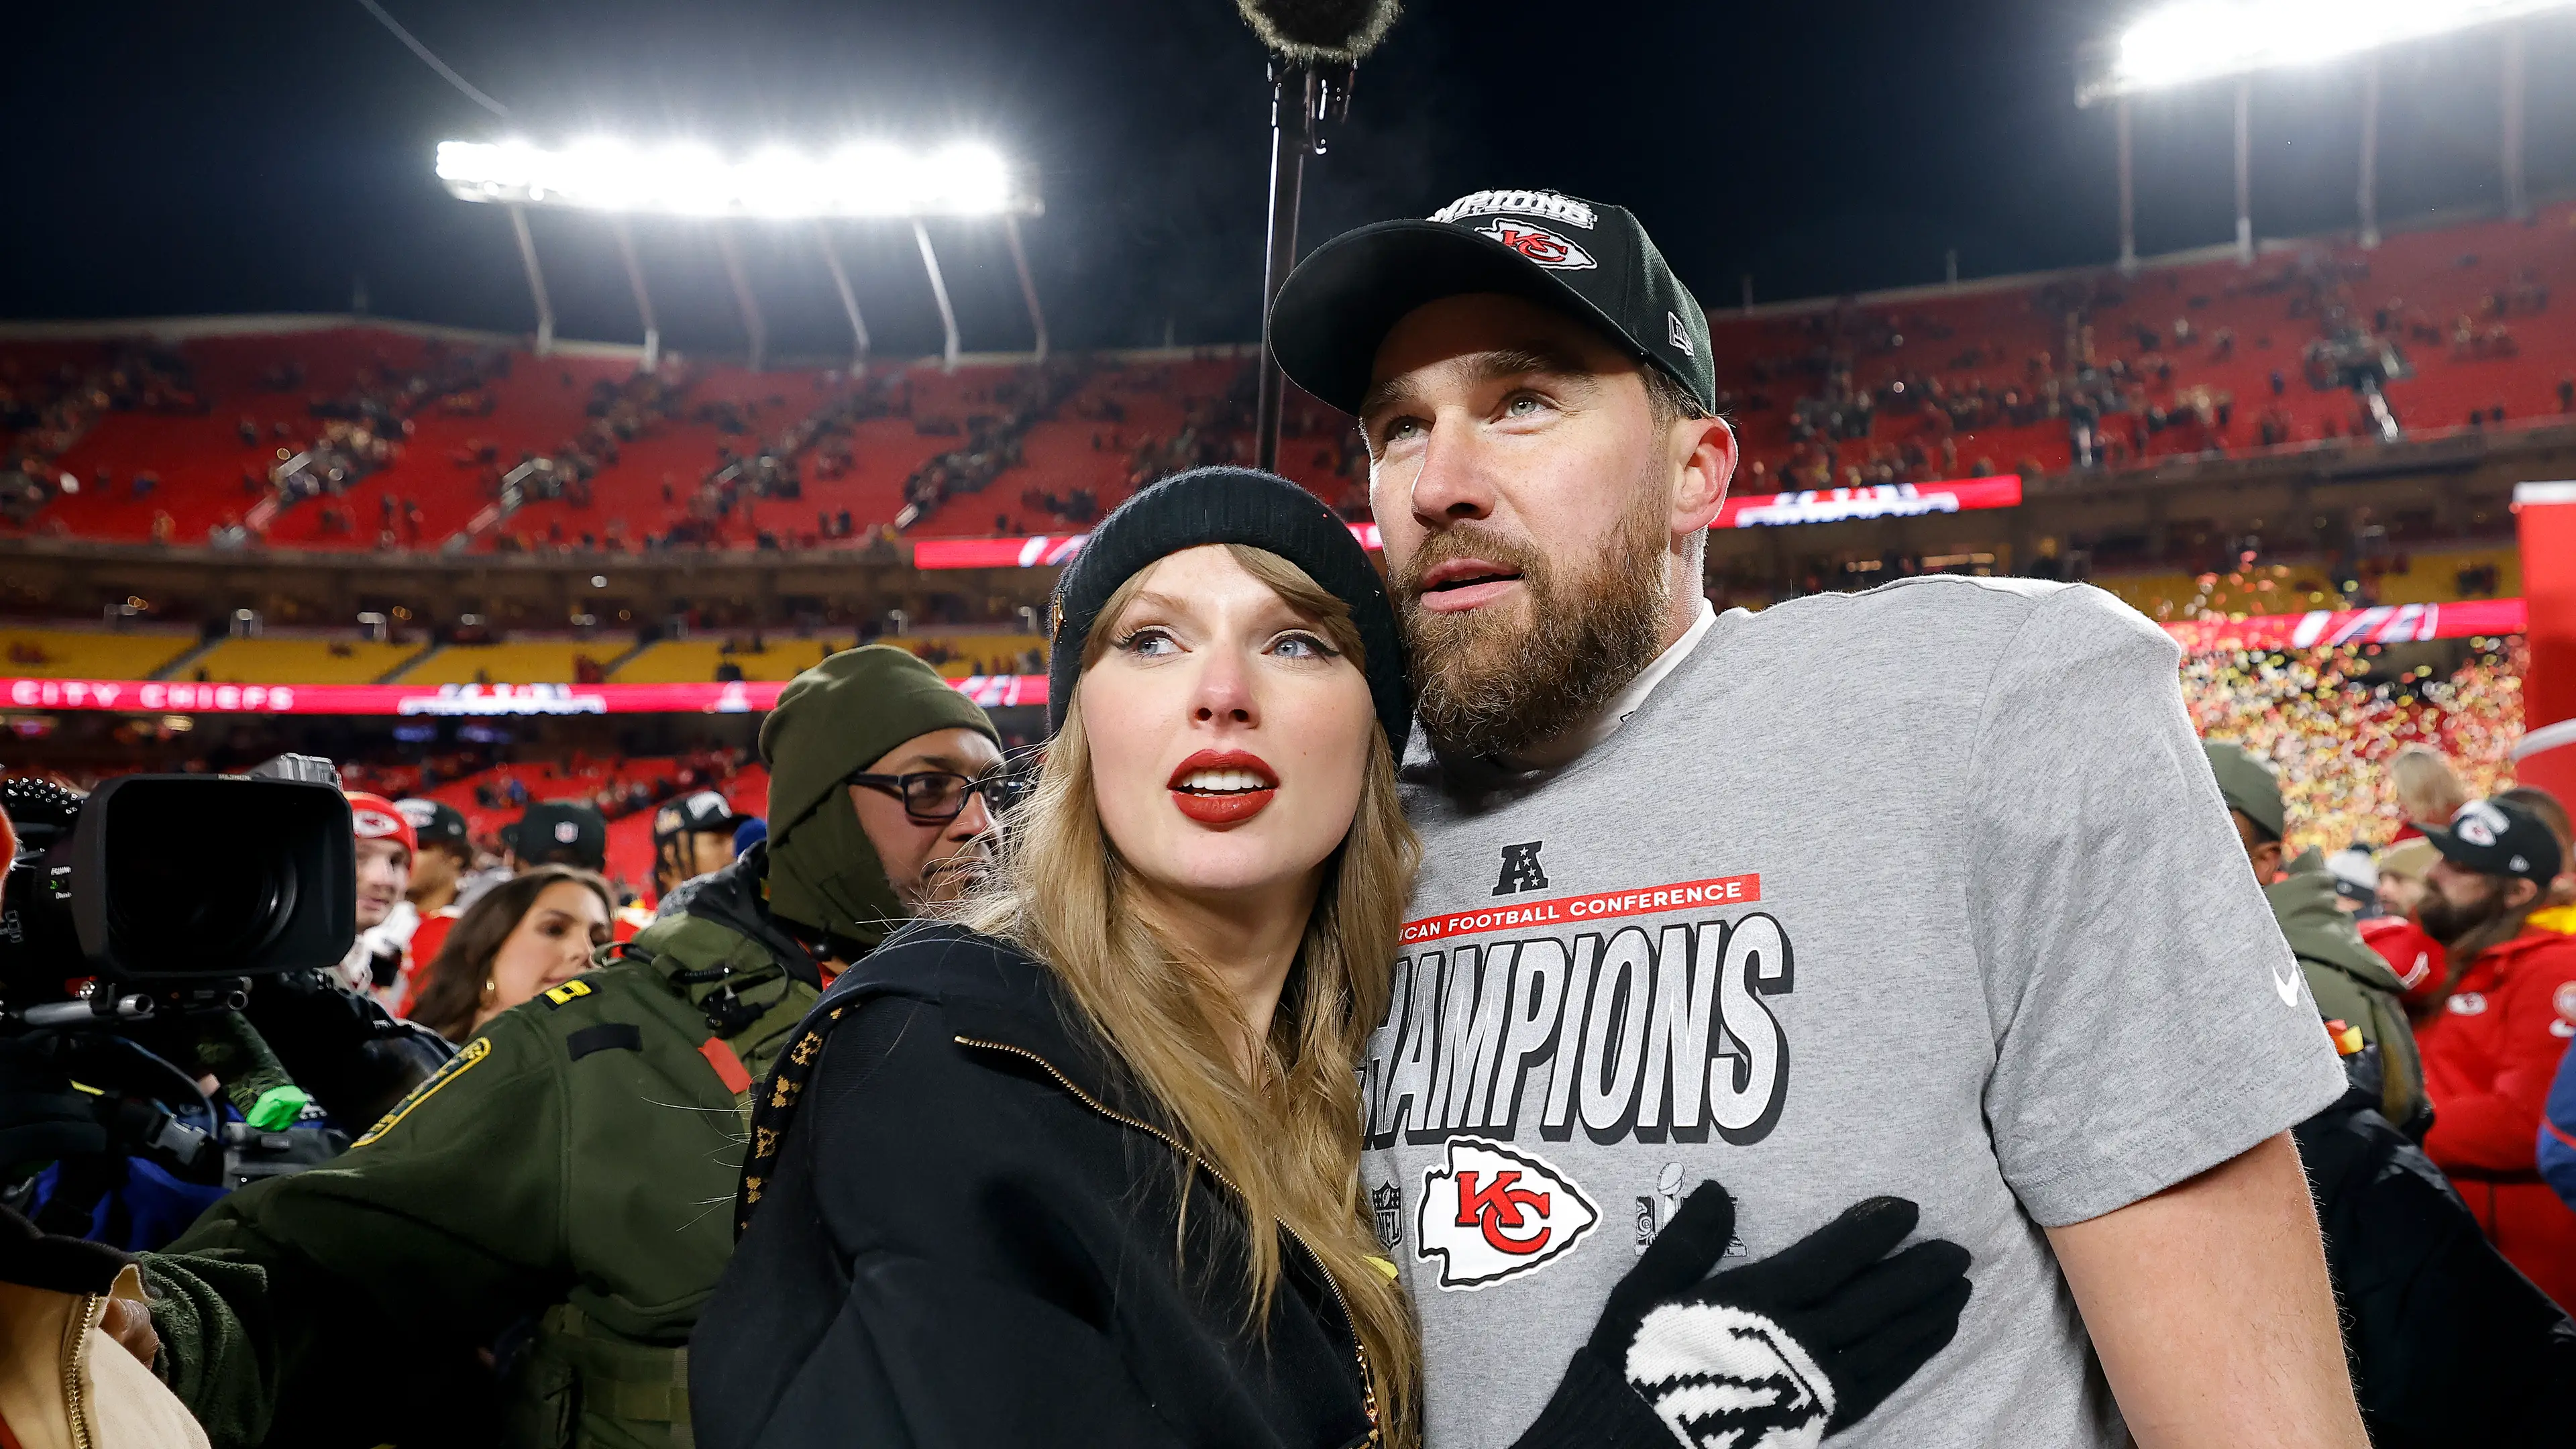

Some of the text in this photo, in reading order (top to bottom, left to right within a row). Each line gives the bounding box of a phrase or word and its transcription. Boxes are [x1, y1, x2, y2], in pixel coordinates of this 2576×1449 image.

[1501, 230, 1568, 262] KC
[11, 680, 294, 710] CITY CHIEFS
[1398, 881, 1742, 942] ICAN FOOTBALL CONFERENCE
[1356, 912, 1795, 1148] HAMPIONS
[1454, 1171, 1551, 1254] KC
